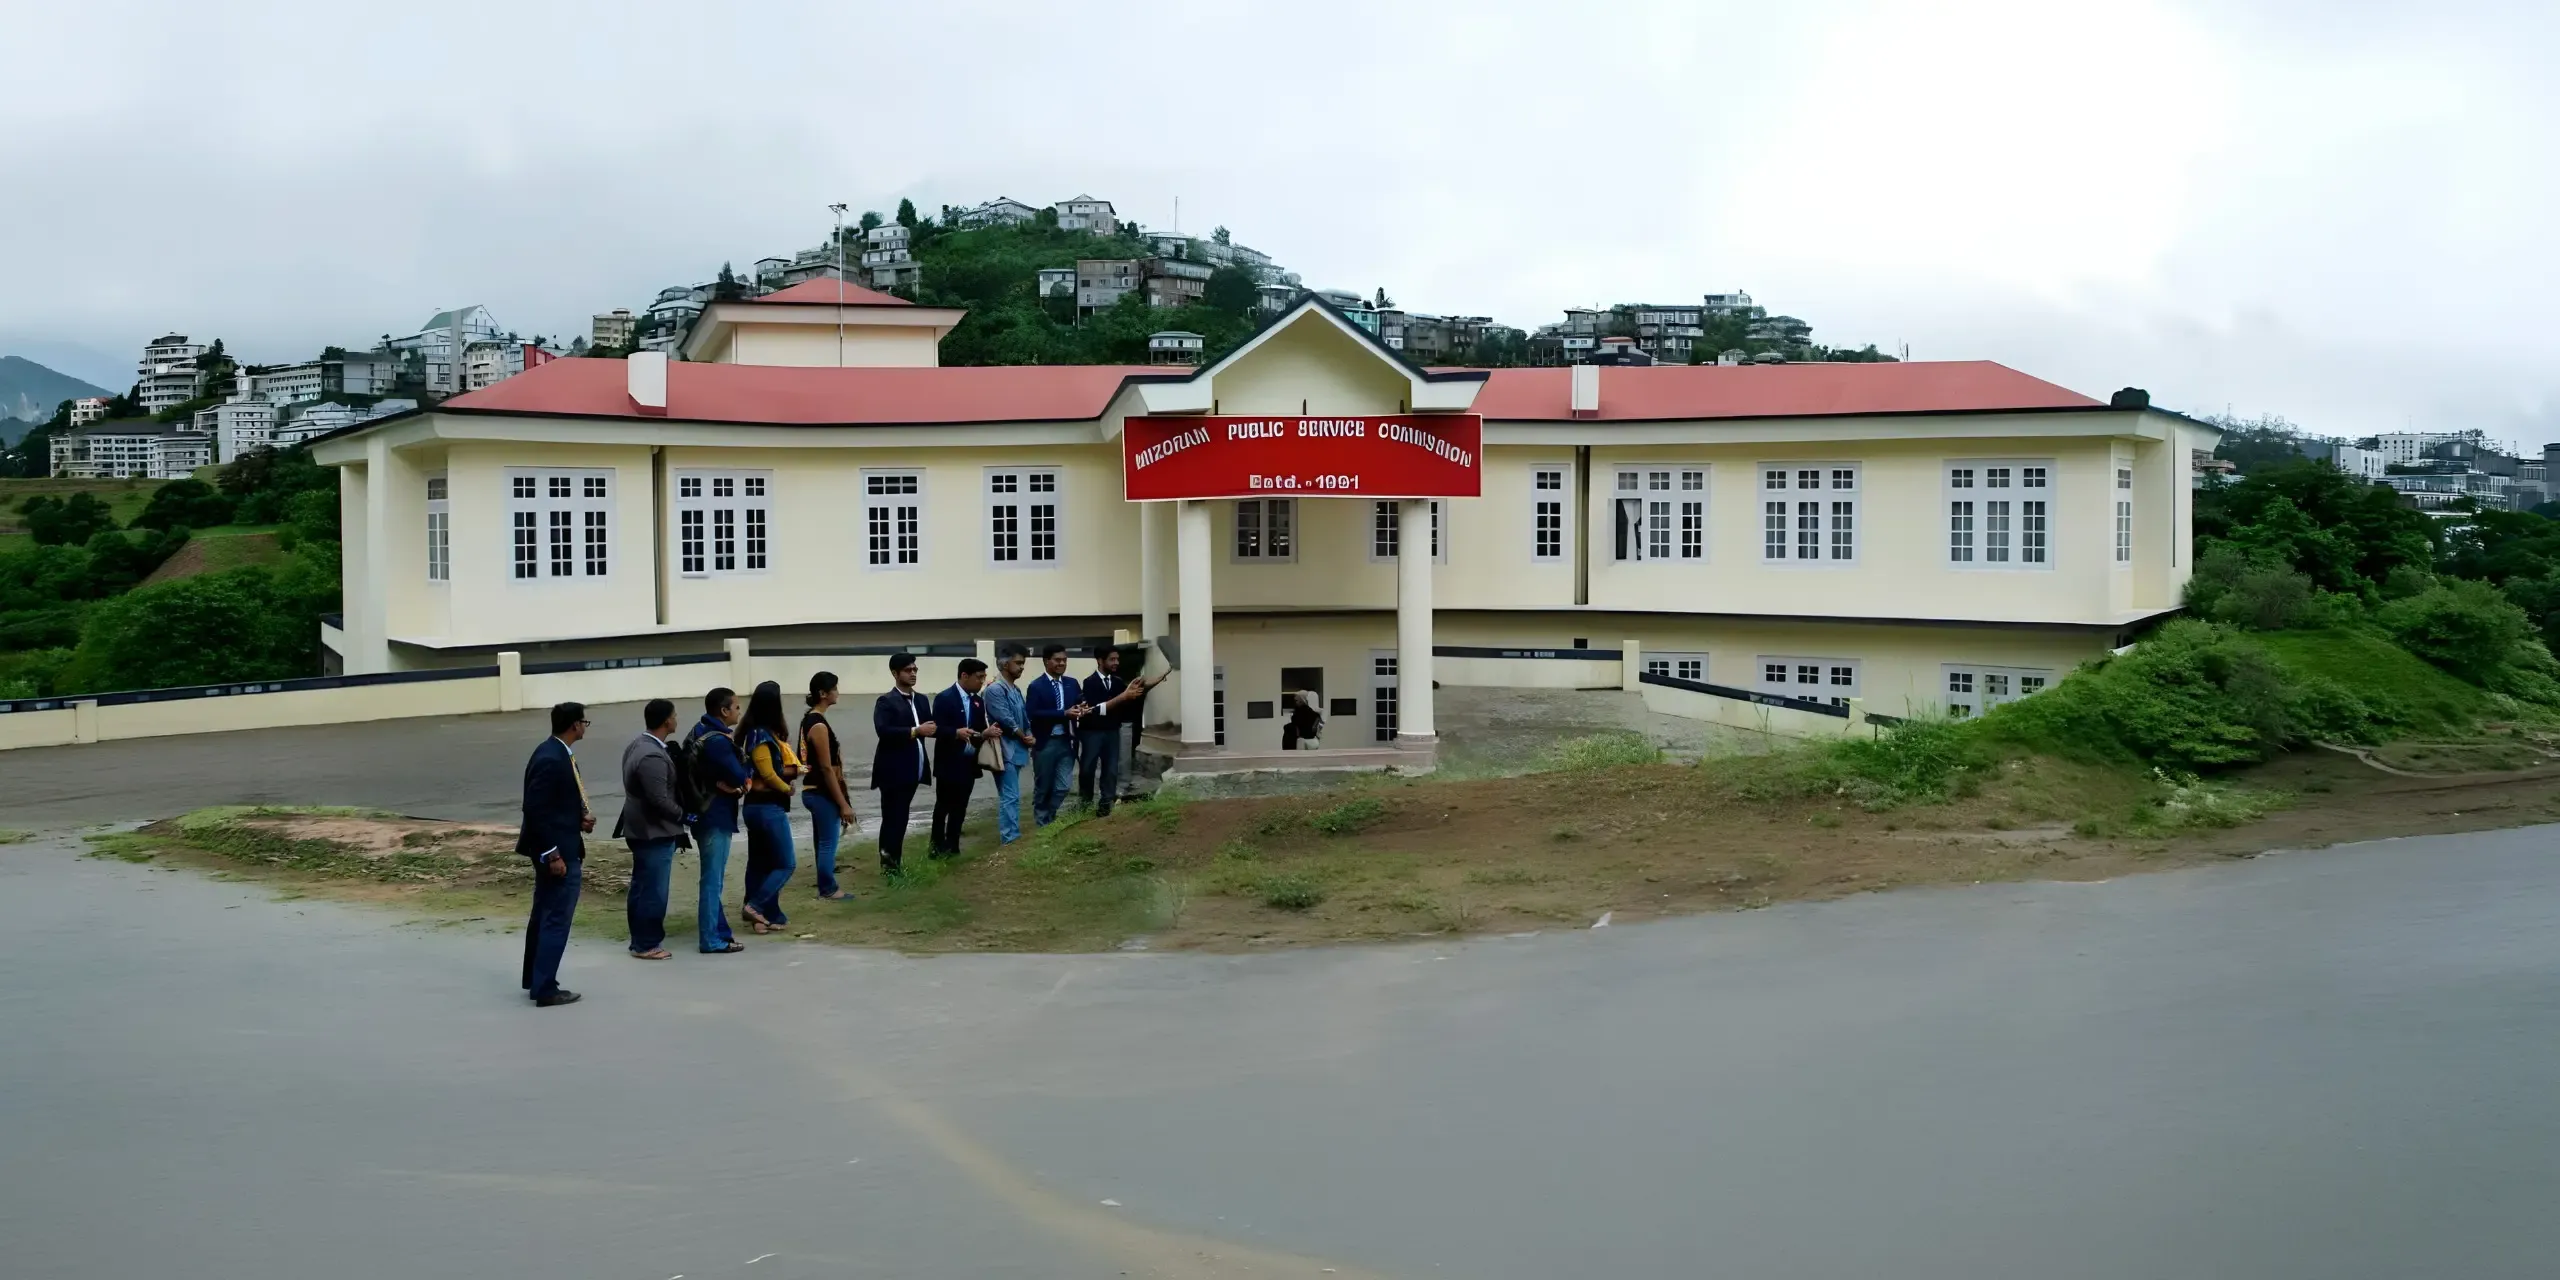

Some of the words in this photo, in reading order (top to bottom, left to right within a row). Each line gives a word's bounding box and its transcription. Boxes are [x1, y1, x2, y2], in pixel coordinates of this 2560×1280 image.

[1135, 426, 1211, 470] MIZORAM
[1228, 421, 1284, 441] PUBLIC
[1297, 420, 1365, 437] SERVICE
